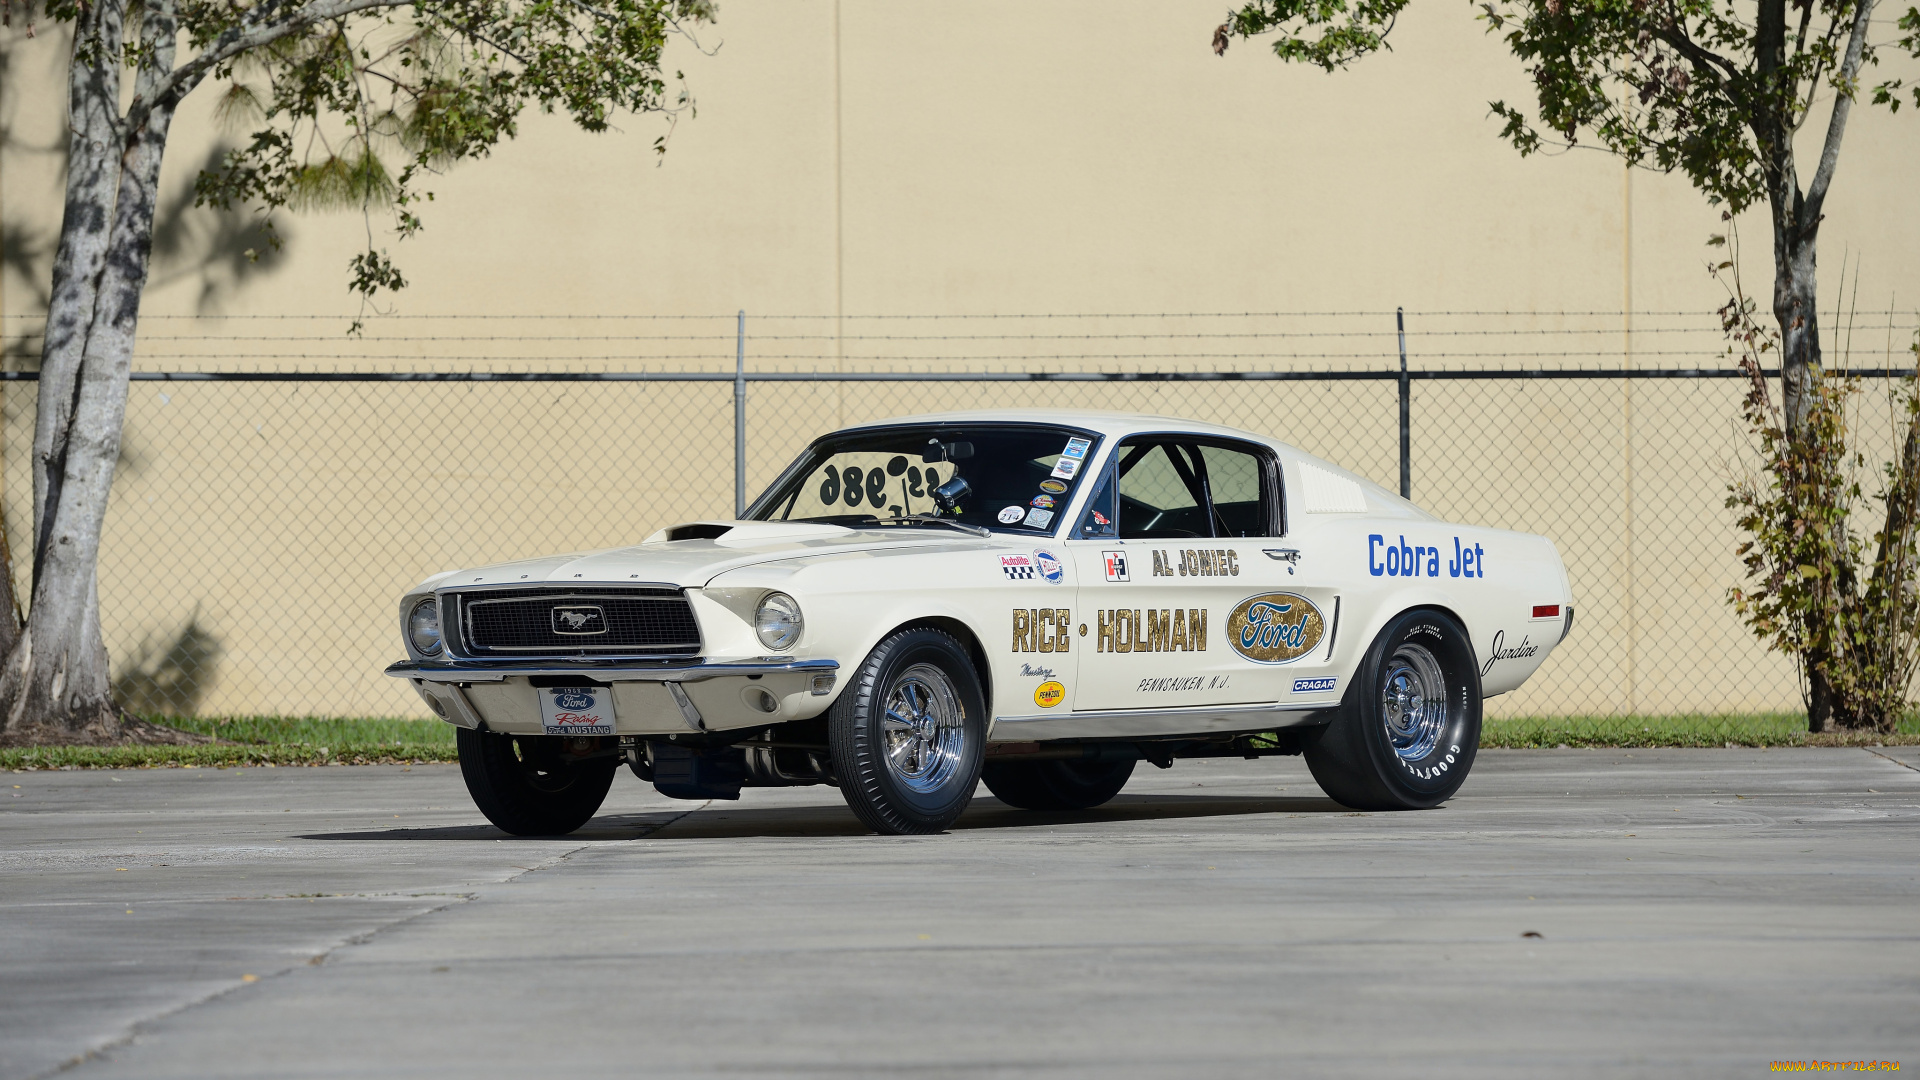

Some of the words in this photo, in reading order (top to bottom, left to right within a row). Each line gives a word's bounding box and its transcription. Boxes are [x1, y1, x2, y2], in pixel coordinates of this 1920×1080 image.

[1000, 513, 1020, 521] 214
[1001, 556, 1030, 566] Autolite
[1152, 549, 1174, 577] AL
[1178, 549, 1239, 577] JONIEC
[1368, 533, 1440, 578] Cobra
[1449, 536, 1484, 579] Jet
[1012, 608, 1071, 653] RICE
[1097, 608, 1208, 653] HOLMAN
[1241, 601, 1309, 650] Ford
[1480, 629, 1539, 677] Jardine
[1020, 662, 1056, 681] Mustang
[1208, 675, 1230, 690] N.J.
[1294, 679, 1335, 691] CRAGAR
[562, 694, 588, 708] Ford
[554, 712, 603, 726] Racing
[547, 726, 566, 735] Ford
[567, 726, 610, 735] MUSTANG
